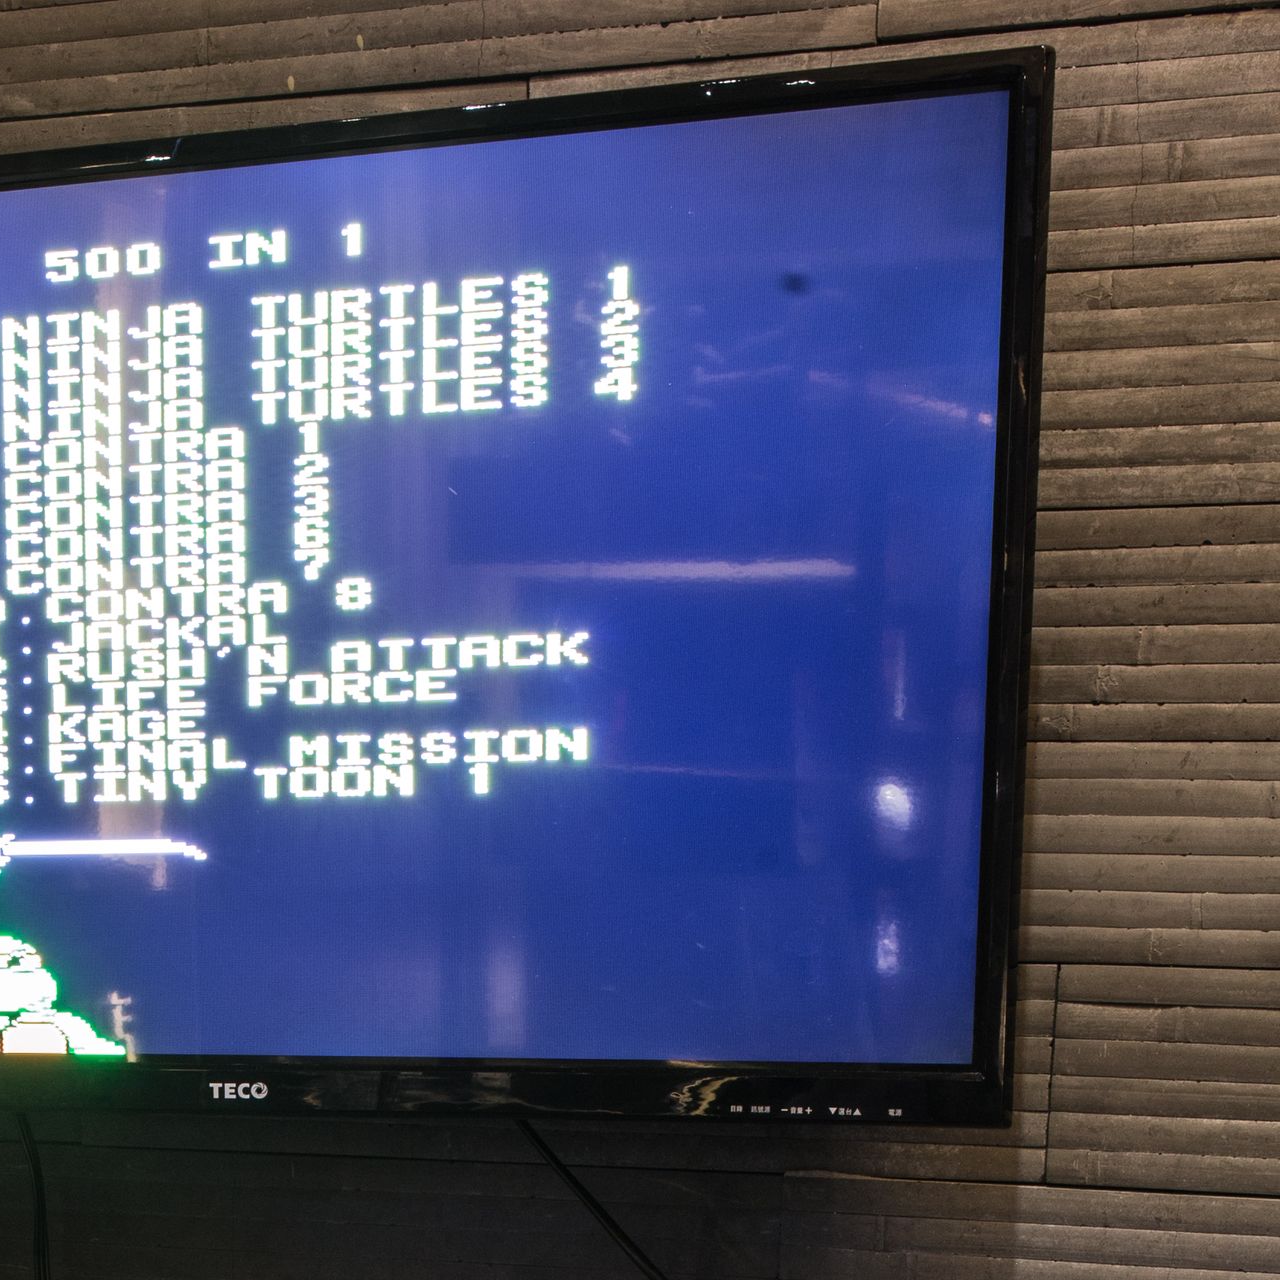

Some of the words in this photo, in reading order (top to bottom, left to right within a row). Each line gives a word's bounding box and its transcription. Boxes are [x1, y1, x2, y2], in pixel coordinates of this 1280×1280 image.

[45, 243, 161, 283] 500
[208, 229, 287, 271] IN
[341, 223, 362, 257] 1
[1, 303, 203, 350] NINJA
[251, 273, 548, 328] TURTLES
[607, 266, 629, 300] 1
[1, 335, 203, 381] NINJA
[251, 306, 548, 360] TURTLES
[600, 300, 639, 335] 2
[2, 366, 204, 412] NINJA
[251, 341, 548, 392] TURTLES
[600, 334, 639, 367] 3
[2, 398, 204, 443] NINJA
[251, 374, 548, 424] TURTLES
[594, 367, 638, 401] 4
[3, 427, 246, 473] CONTRA
[298, 422, 319, 454] 1
[4, 459, 246, 503] CONTRA
[293, 454, 330, 486] 2
[4, 490, 246, 534] CONTRA
[293, 485, 330, 517] 3
[5, 522, 246, 565] CONTRA
[294, 517, 330, 549] 6
[6, 553, 247, 595] CONTRA
[294, 548, 330, 580] 7
[45, 582, 288, 623] CONTRA
[335, 577, 372, 610] 8
[51, 613, 287, 652] JACKAL
[330, 632, 589, 673] ATTACK
[51, 678, 206, 713] LIFE
[247, 669, 458, 707] FORCE
[47, 708, 206, 742] KAGE
[48, 737, 247, 773] FINAL
[289, 728, 589, 767] MISSION
[53, 769, 207, 803] TINY
[253, 764, 414, 799] TOON
[468, 763, 489, 794] 1
[208, 1082, 269, 1100] TECO
